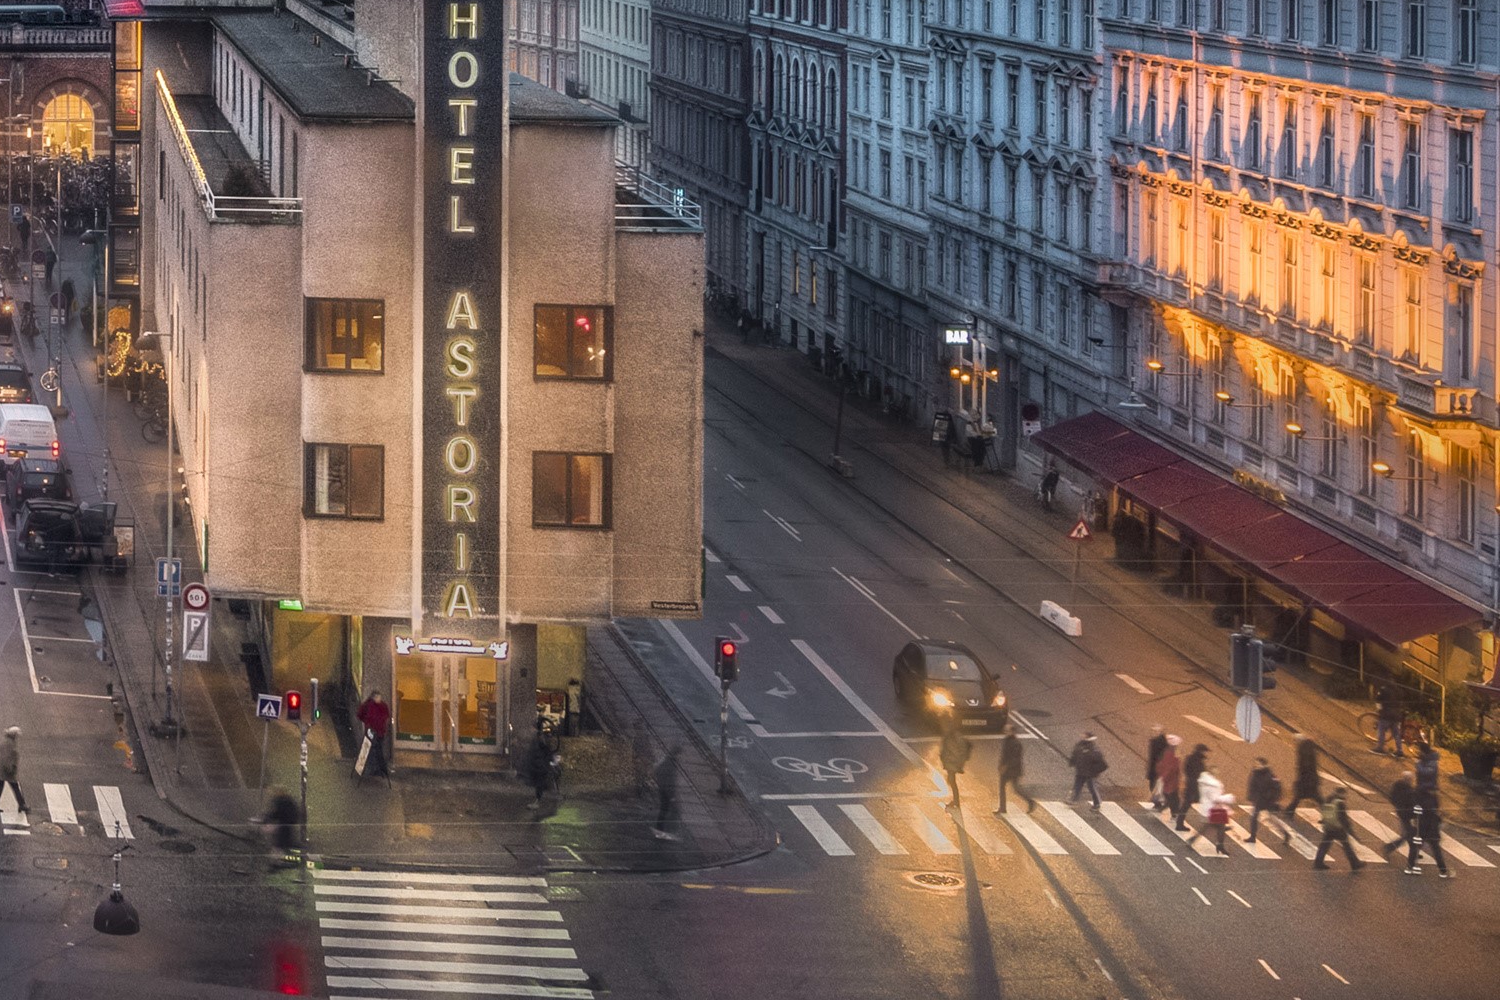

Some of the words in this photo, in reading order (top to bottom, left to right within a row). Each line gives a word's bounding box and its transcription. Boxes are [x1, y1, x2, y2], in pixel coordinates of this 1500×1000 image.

[447, 2, 479, 234] HOTEL
[13, 206, 21, 216] P
[945, 329, 969, 344] BAR
[445, 291, 478, 618] ASTORIA
[190, 617, 202, 632] P
